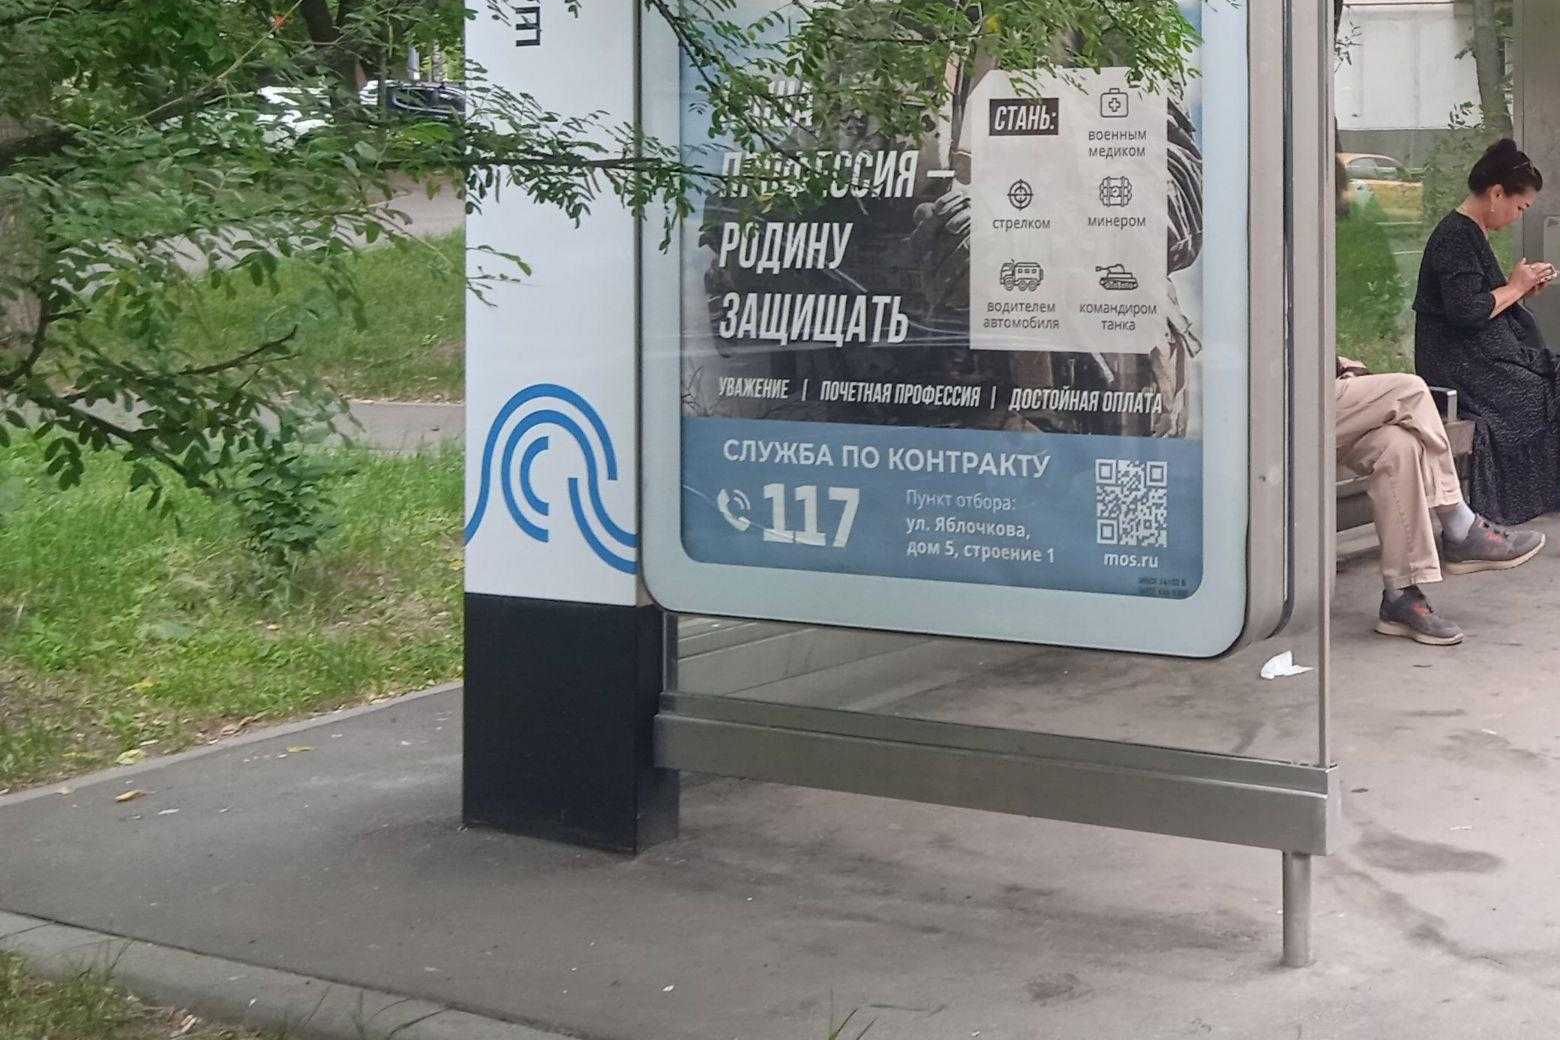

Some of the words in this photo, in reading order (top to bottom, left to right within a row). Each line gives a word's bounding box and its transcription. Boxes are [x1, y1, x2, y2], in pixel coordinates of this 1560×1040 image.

[993, 104, 1057, 131] СТАНЬ:
[1088, 129, 1147, 141] военным
[1088, 146, 1146, 159] медиком
[992, 217, 1051, 232] стрелком
[1087, 216, 1147, 232] минером
[718, 221, 854, 275] РОДИНУ
[986, 301, 1056, 315] водителем
[1079, 302, 1158, 316] командиром
[718, 291, 909, 348] ЗАЩИЩАТЬ
[983, 316, 1060, 330] автомобиля
[1101, 319, 1136, 331] танка
[718, 376, 790, 400] УВАЖЕНИЕ
[819, 380, 892, 404] ПОЧЕТНАЯ
[894, 383, 981, 408] ПРОФЕССИЯ
[1008, 385, 1100, 412] ДОСТОЙНАЯ
[1102, 390, 1163, 414] ОПЛАТА
[723, 439, 834, 466] СЛУЖБА
[842, 445, 880, 469] ПО
[889, 447, 1051, 479] КОНТРАКТУ
[906, 489, 953, 510] Пункт
[956, 492, 1016, 513] отбора:
[763, 483, 860, 548] 117
[906, 517, 930, 534] ул.
[935, 516, 1031, 540] Яблочкова,
[906, 540, 940, 557] дом
[944, 540, 959, 558] 5,
[964, 544, 1043, 562] строение
[1047, 547, 1055, 564] 1
[1103, 553, 1159, 569] mos.ru
